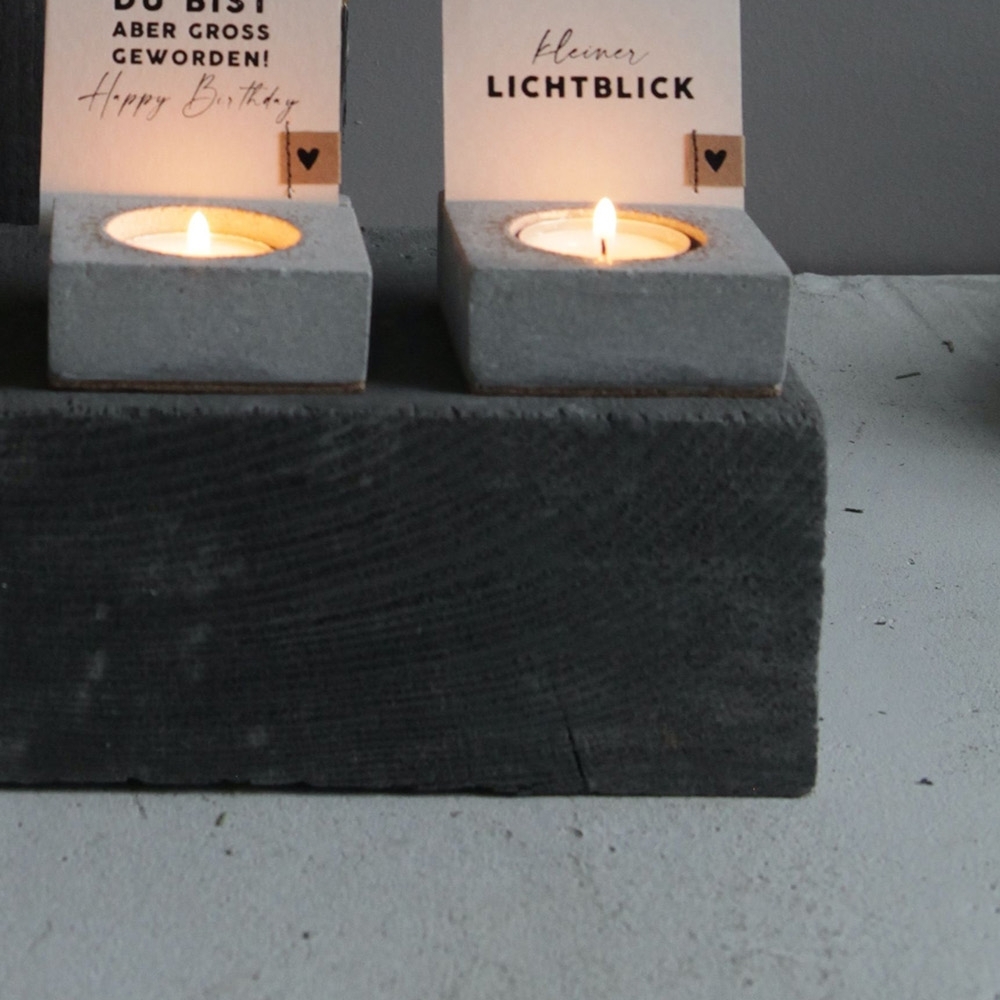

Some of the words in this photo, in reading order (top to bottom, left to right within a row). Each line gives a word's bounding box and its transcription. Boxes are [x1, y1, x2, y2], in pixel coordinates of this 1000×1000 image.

[112, 21, 176, 39] ABER
[188, 23, 270, 41] GROSS
[112, 48, 269, 68] GEWORDEN!
[532, 28, 649, 66] kleiner
[78, 70, 171, 121] Happy
[182, 73, 300, 124] Birthday
[487, 75, 695, 100] LICHTBLICK
